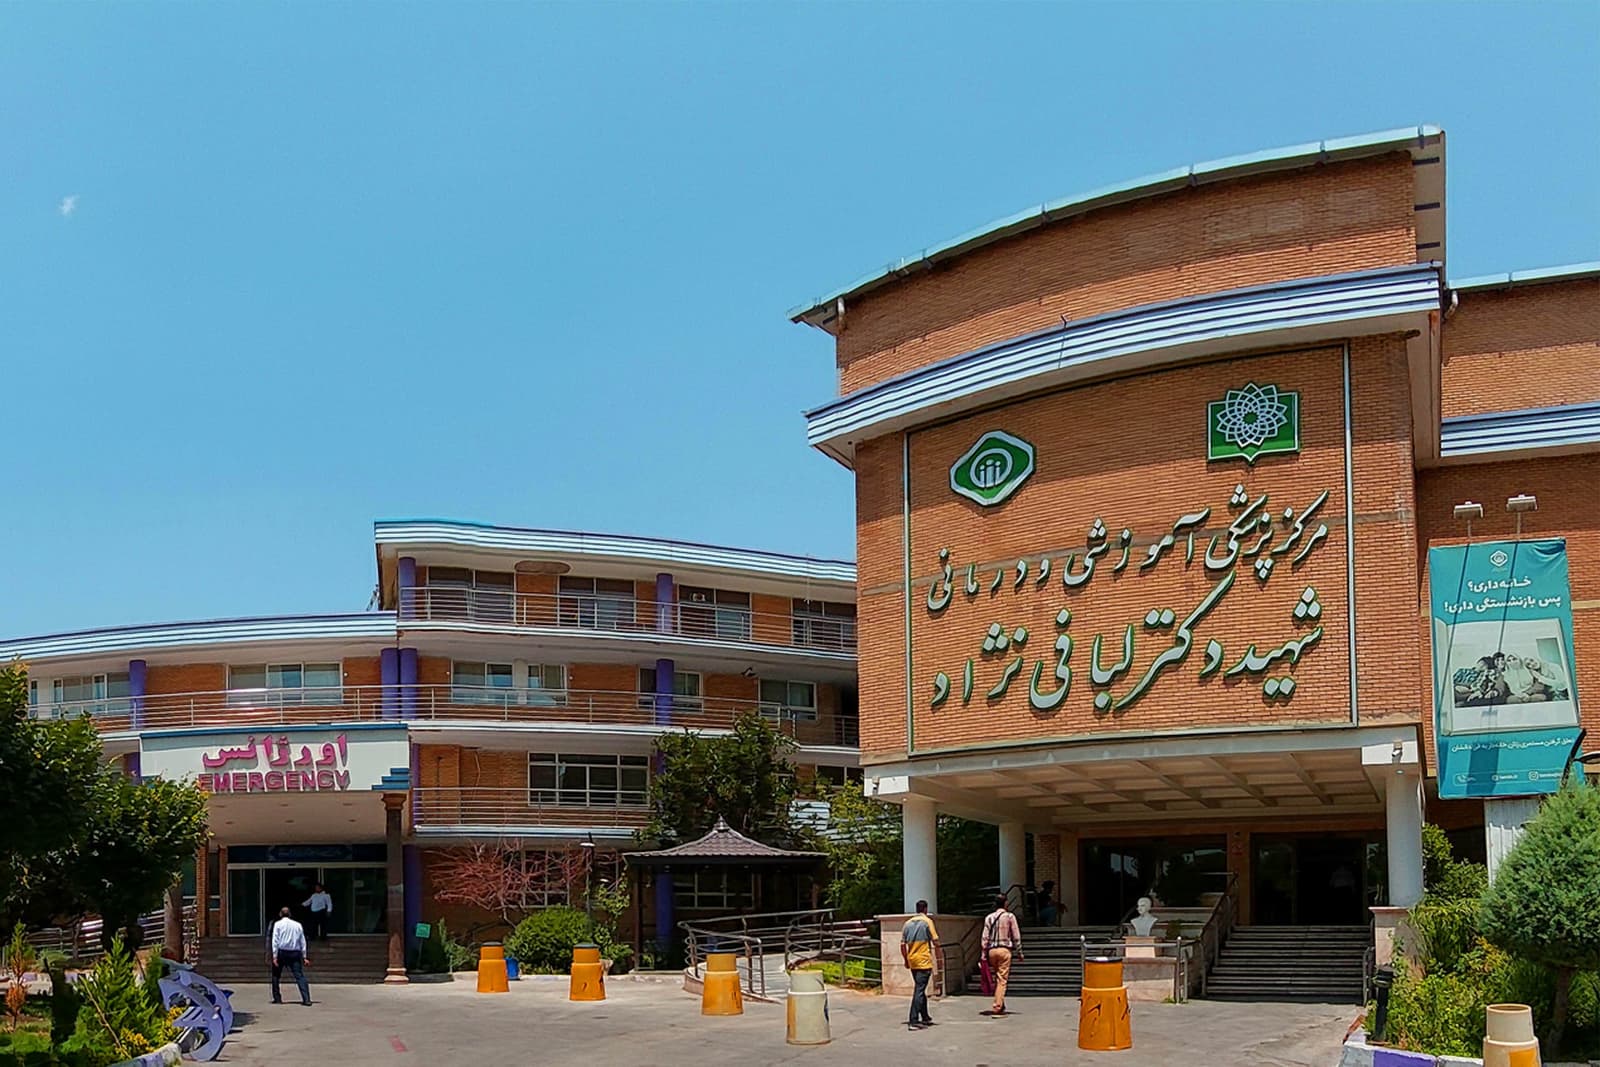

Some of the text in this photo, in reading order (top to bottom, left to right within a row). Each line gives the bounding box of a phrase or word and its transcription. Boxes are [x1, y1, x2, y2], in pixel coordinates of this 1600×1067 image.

[1063, 507, 1211, 586] آموزشی
[1204, 483, 1274, 581] پزشکی
[1271, 489, 1328, 563] مرکز
[927, 547, 1028, 612] درمانی
[1475, 595, 1535, 612] بازنشستگی
[1538, 596, 1561, 607] پس
[930, 571, 1323, 711] شهید دکتر لبافی نژاد
[199, 769, 350, 791] EMERGENCY
[202, 733, 347, 768] اورژانس
